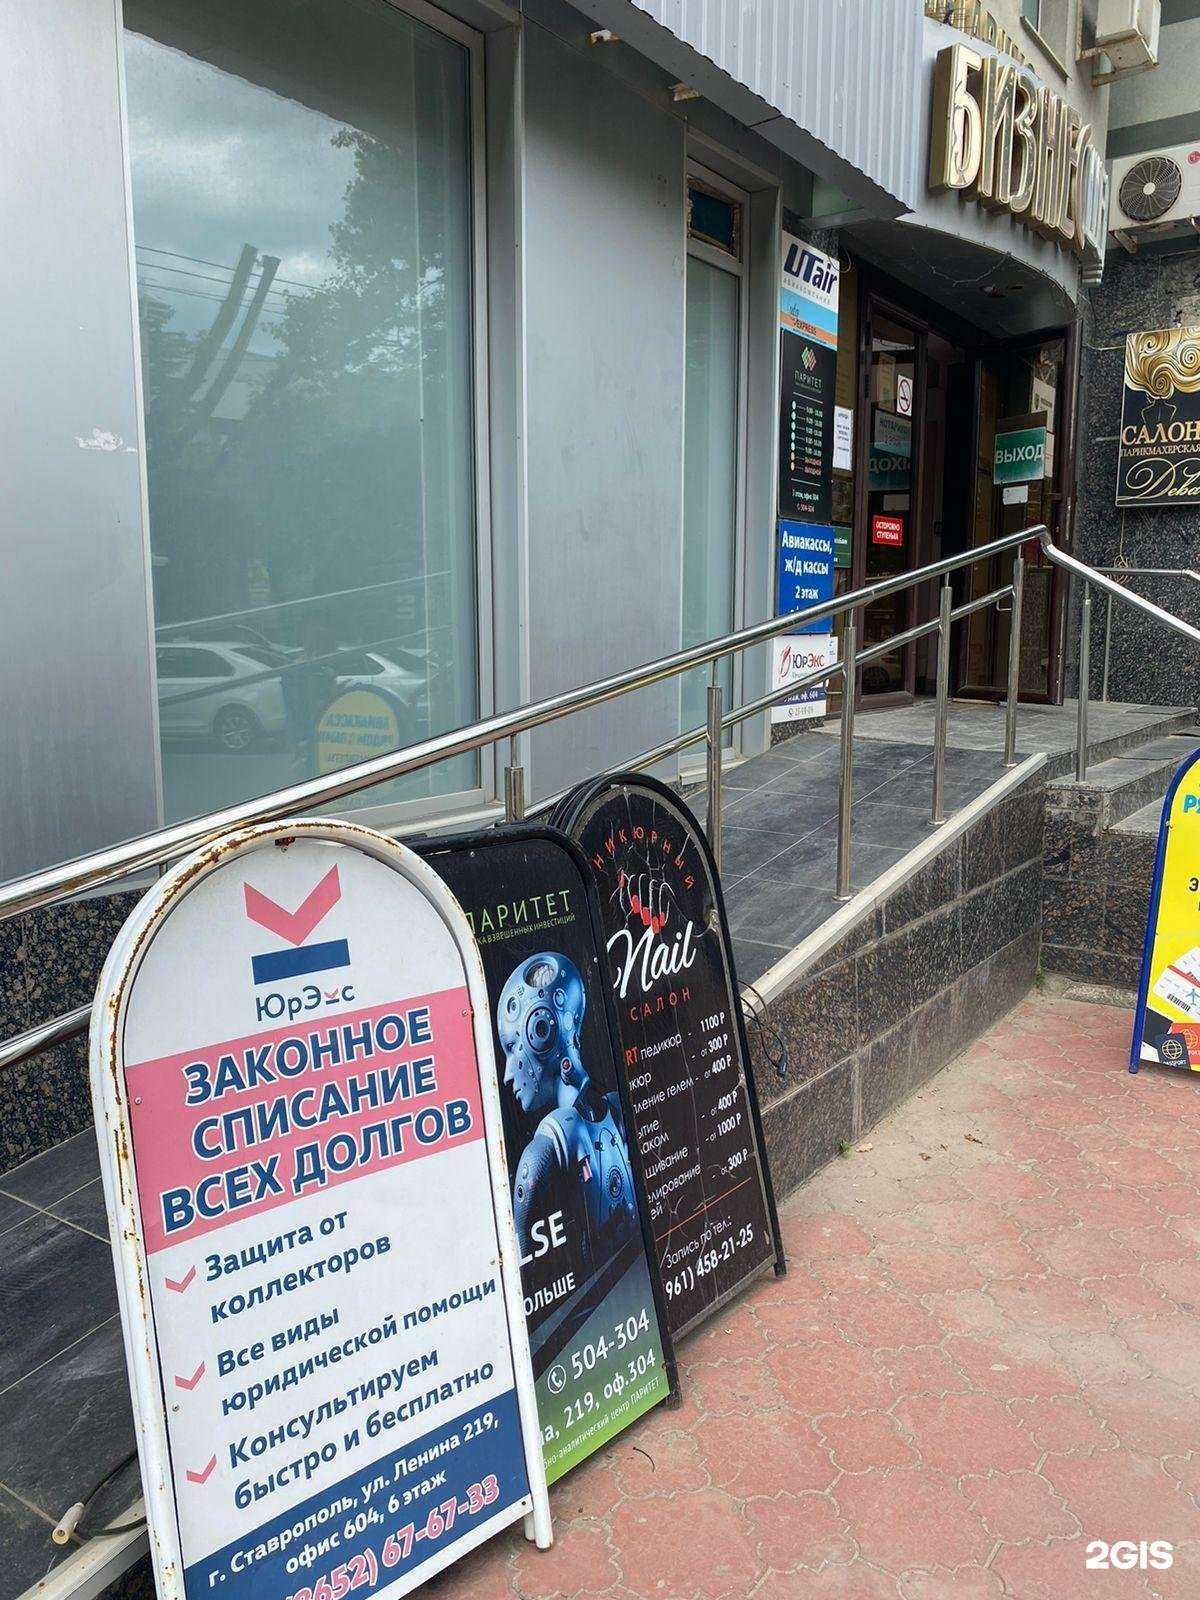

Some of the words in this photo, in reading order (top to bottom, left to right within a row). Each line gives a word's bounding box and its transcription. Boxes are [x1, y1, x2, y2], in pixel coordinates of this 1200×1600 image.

[994, 443, 1045, 465] ВЫХОД
[1122, 420, 1200, 446] САЛОН
[782, 530, 833, 555] Авиакассы,
[803, 561, 829, 576] кассы
[795, 585, 801, 599] 2
[801, 587, 819, 600] этаж
[465, 889, 570, 935] ПАРИТЕТ
[606, 920, 697, 999] Nail
[630, 986, 692, 1022] САЛОН
[183, 1006, 434, 1107] ЗАКОННОЕ
[640, 1033, 682, 1060] педикюр
[700, 1013, 719, 1033] 1100
[707, 1036, 723, 1053] 300
[666, 1077, 694, 1096] гелем
[711, 1057, 726, 1074] 400
[191, 1056, 437, 1161] СПИСАНИЕ
[717, 1095, 732, 1111] 400
[717, 1117, 736, 1137] 1000
[160, 1154, 286, 1236] ВСЕХ
[289, 1099, 474, 1196] ДОЛГОВ
[727, 1153, 743, 1171] 300
[205, 1224, 313, 1282] Защита
[319, 1210, 348, 1237] от
[665, 1236, 700, 1269] Запись
[696, 1223, 754, 1278] 458-21-25
[210, 1236, 391, 1324] коллекторов
[217, 1341, 265, 1377] Все
[272, 1307, 340, 1353] виды
[221, 1314, 398, 1416] юридической
[403, 1278, 497, 1330] помощи
[571, 1308, 650, 1380] 504-304
[229, 1349, 439, 1470] Консультируем
[563, 1391, 600, 1429] 219,
[611, 1401, 630, 1421] центр
[630, 1377, 660, 1405] ПАРИТЕТ
[233, 1442, 337, 1510] быстро
[344, 1433, 360, 1452] и
[366, 1361, 495, 1438] бесплатно
[208, 1568, 227, 1588] г.
[230, 1494, 360, 1574] Ставрополь,
[361, 1475, 391, 1505] ул.
[393, 1435, 461, 1482] Ленина
[462, 1411, 500, 1441] 219,
[285, 1533, 341, 1574] офис
[343, 1506, 385, 1540] 604,
[387, 1494, 400, 1513] 6
[400, 1471, 448, 1506] этаж
[380, 1473, 500, 1567] 67-67-33
